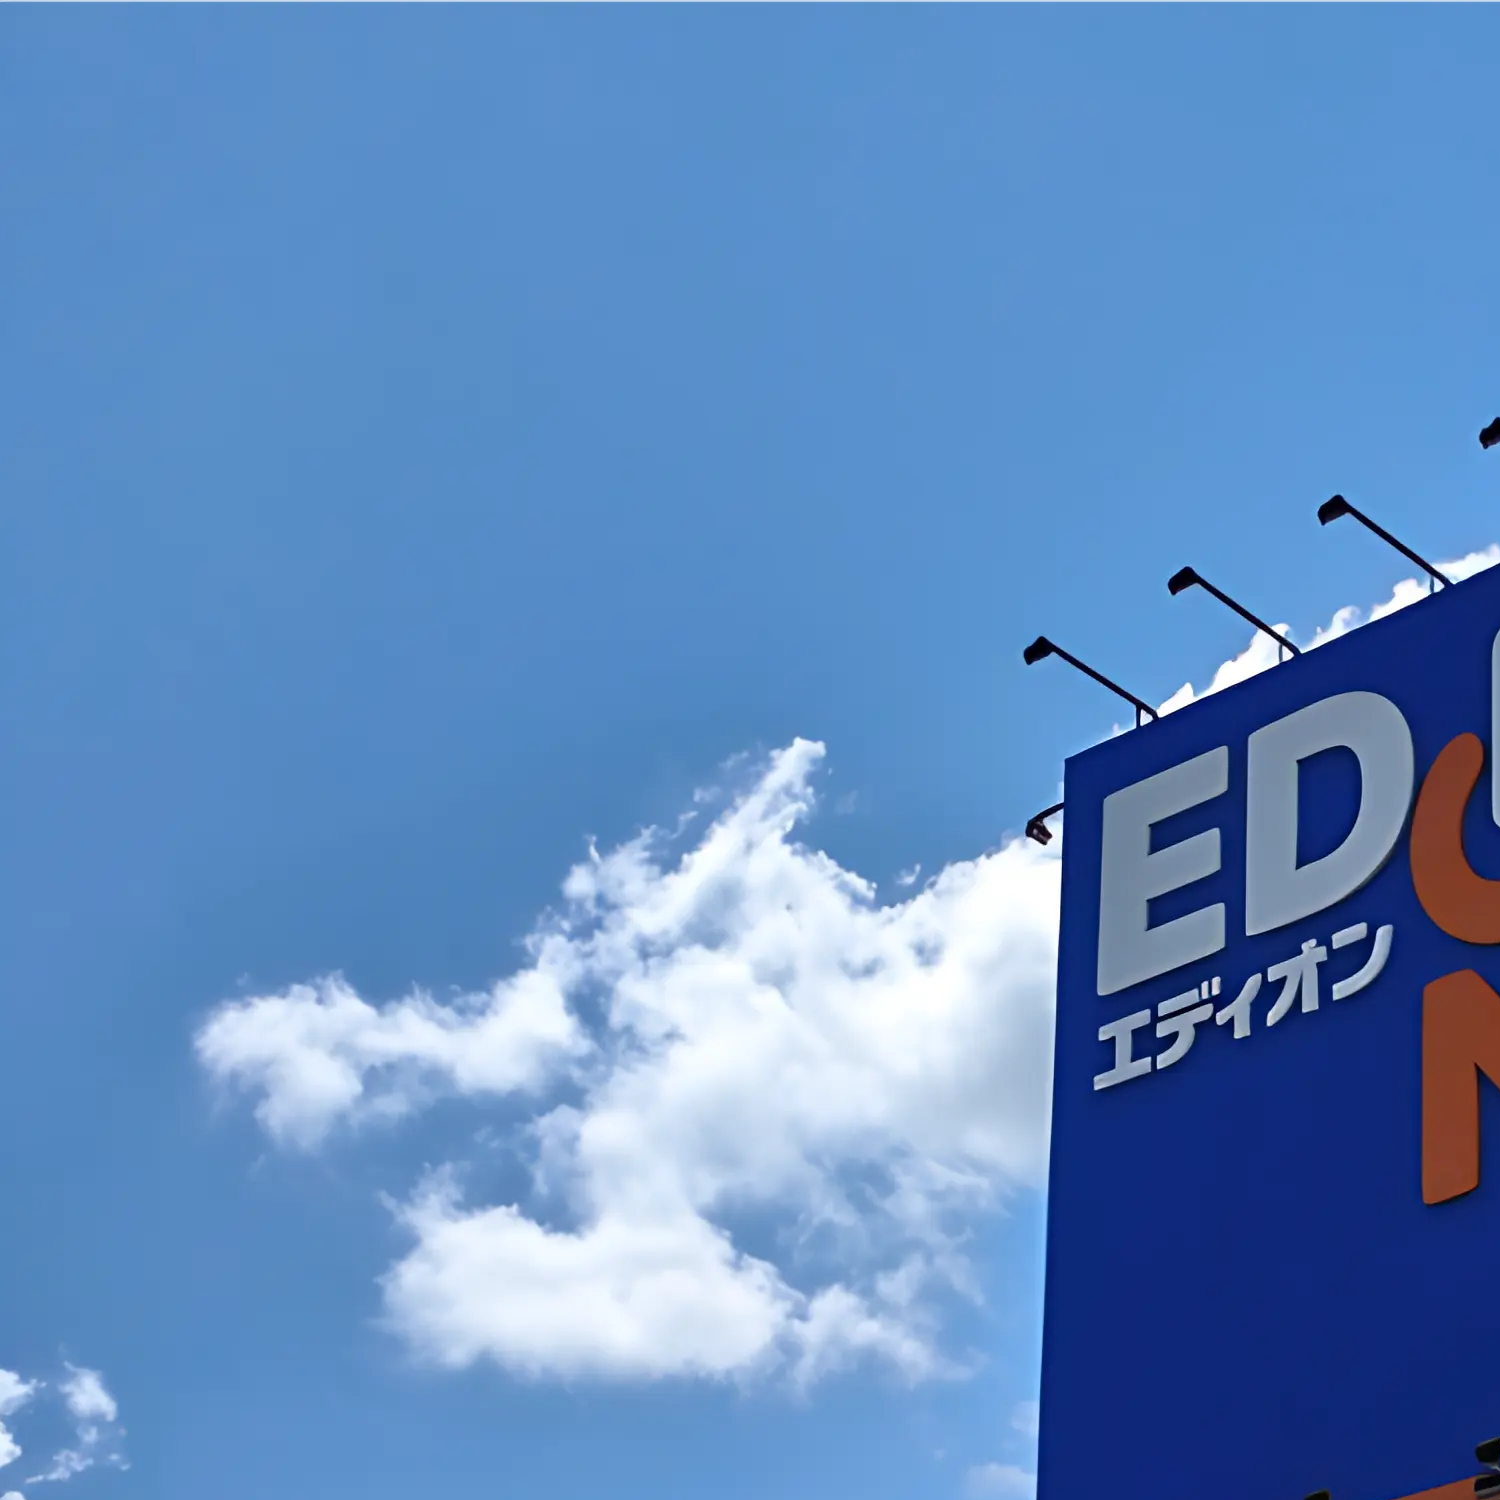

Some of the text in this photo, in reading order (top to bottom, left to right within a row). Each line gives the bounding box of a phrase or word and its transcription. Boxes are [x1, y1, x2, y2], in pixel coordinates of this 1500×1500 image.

[1093, 922, 1395, 1092] エディオン
